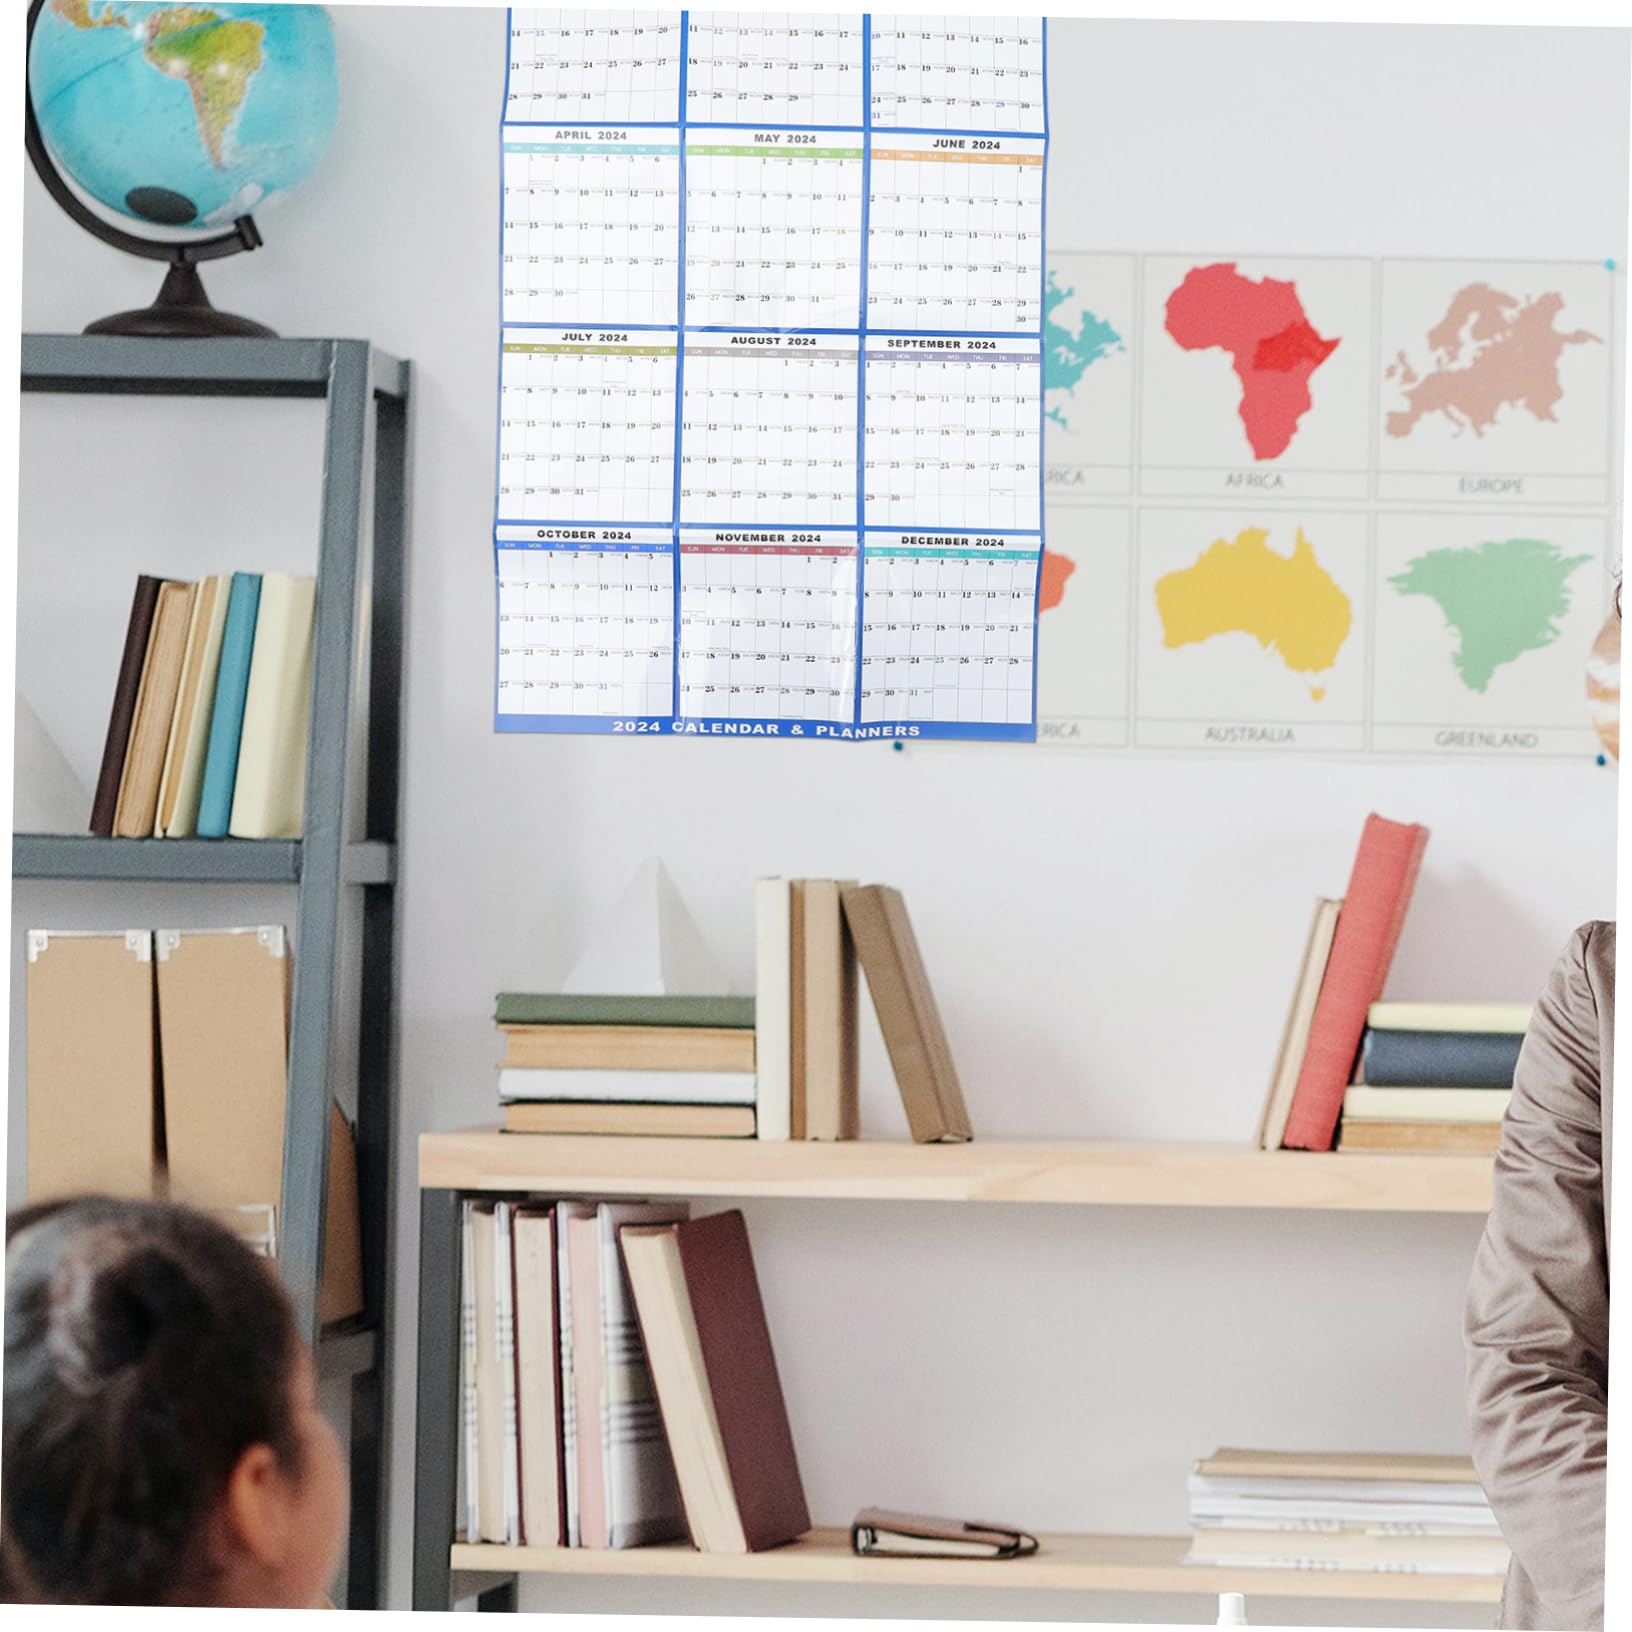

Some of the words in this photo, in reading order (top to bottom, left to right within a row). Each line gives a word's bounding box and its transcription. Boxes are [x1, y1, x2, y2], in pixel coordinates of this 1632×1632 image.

[555, 131, 592, 140] APRIL
[598, 131, 627, 140] 2024
[754, 134, 780, 142] MAY
[787, 134, 816, 144] 2024
[933, 139, 965, 148] JUNE
[972, 140, 1000, 150] 2024
[562, 333, 592, 341] JULY
[599, 334, 628, 342] 2024
[731, 336, 781, 344] AUGUST
[788, 338, 816, 346] 2024
[888, 340, 960, 348] SEPTEMBER
[968, 341, 996, 349] 2024
[1225, 473, 1284, 491] AFRICA
[1459, 477, 1524, 494] EUROPE
[537, 530, 596, 539] OCTOBER
[602, 532, 631, 540] 2024
[716, 534, 784, 542] NOVEMBER
[792, 534, 821, 542] 2024
[902, 536, 968, 546] DECEMBER
[976, 538, 1004, 546] 2024
[755, 686, 765, 694] 27
[613, 721, 661, 732] 2024
[672, 723, 778, 734] CALENDAR
[791, 726, 803, 735] &
[816, 726, 920, 738] PLANNERS
[1205, 726, 1296, 743] AUSTRALIA
[1435, 731, 1538, 748] GREENLAND
